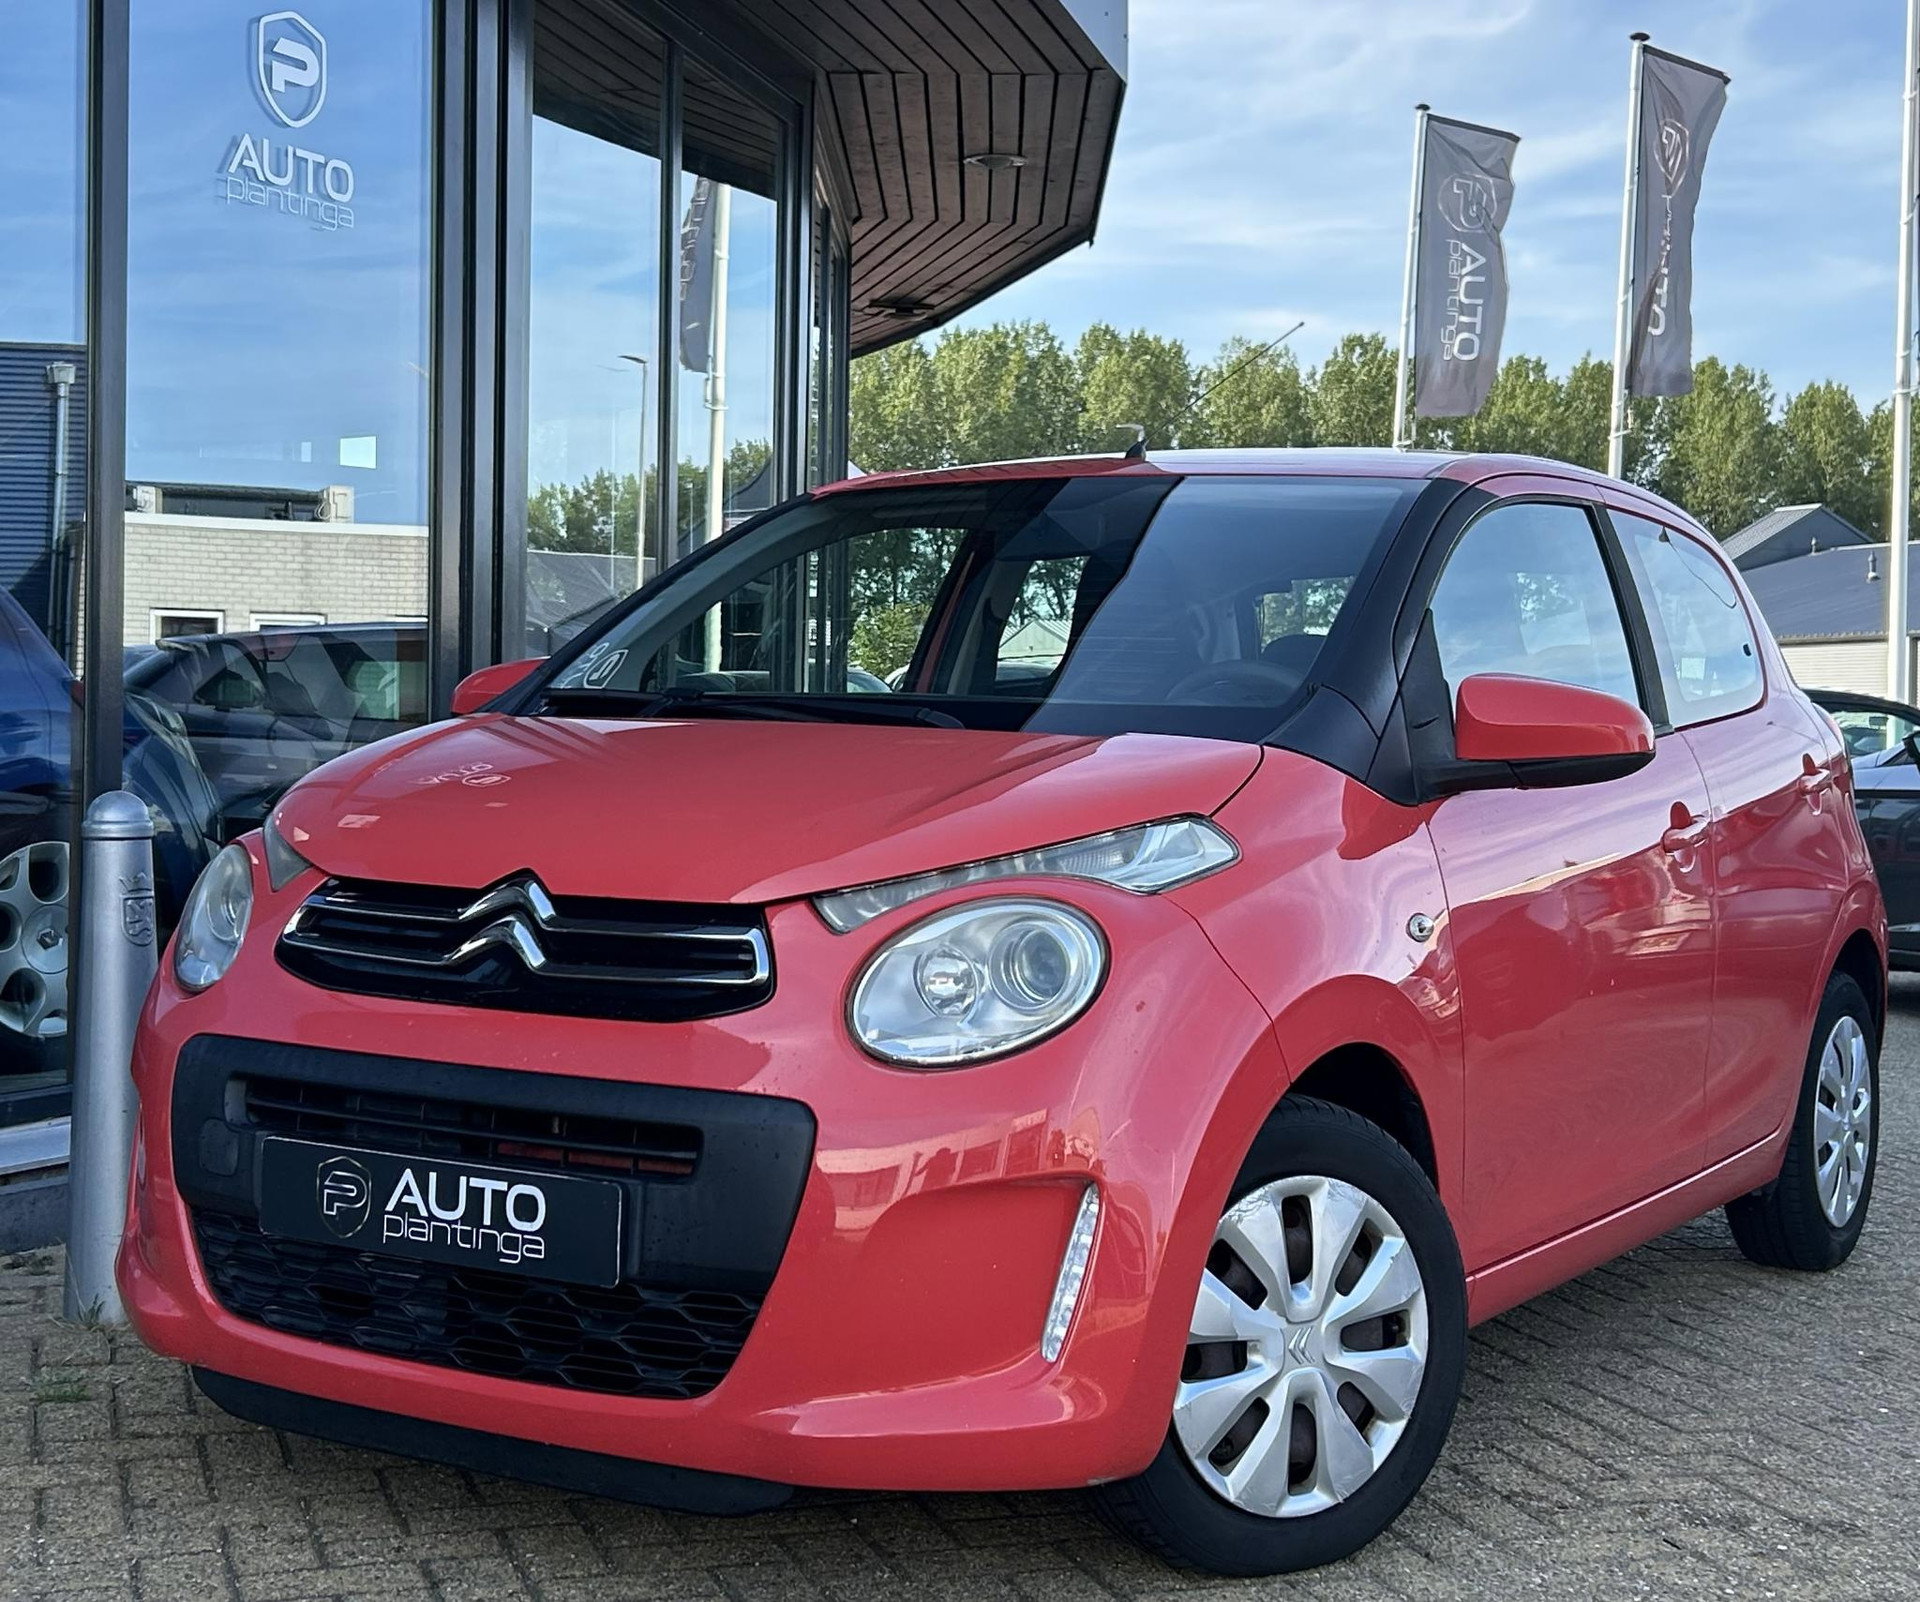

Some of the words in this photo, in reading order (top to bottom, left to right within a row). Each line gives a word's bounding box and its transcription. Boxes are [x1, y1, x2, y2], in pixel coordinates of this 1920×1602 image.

[228, 133, 354, 203] AUTO
[226, 176, 354, 232] plantinga
[1440, 239, 1463, 362] plantinga
[1453, 242, 1487, 362] AUTO
[384, 1168, 546, 1232] AUTO
[382, 1212, 545, 1263] plantinga
